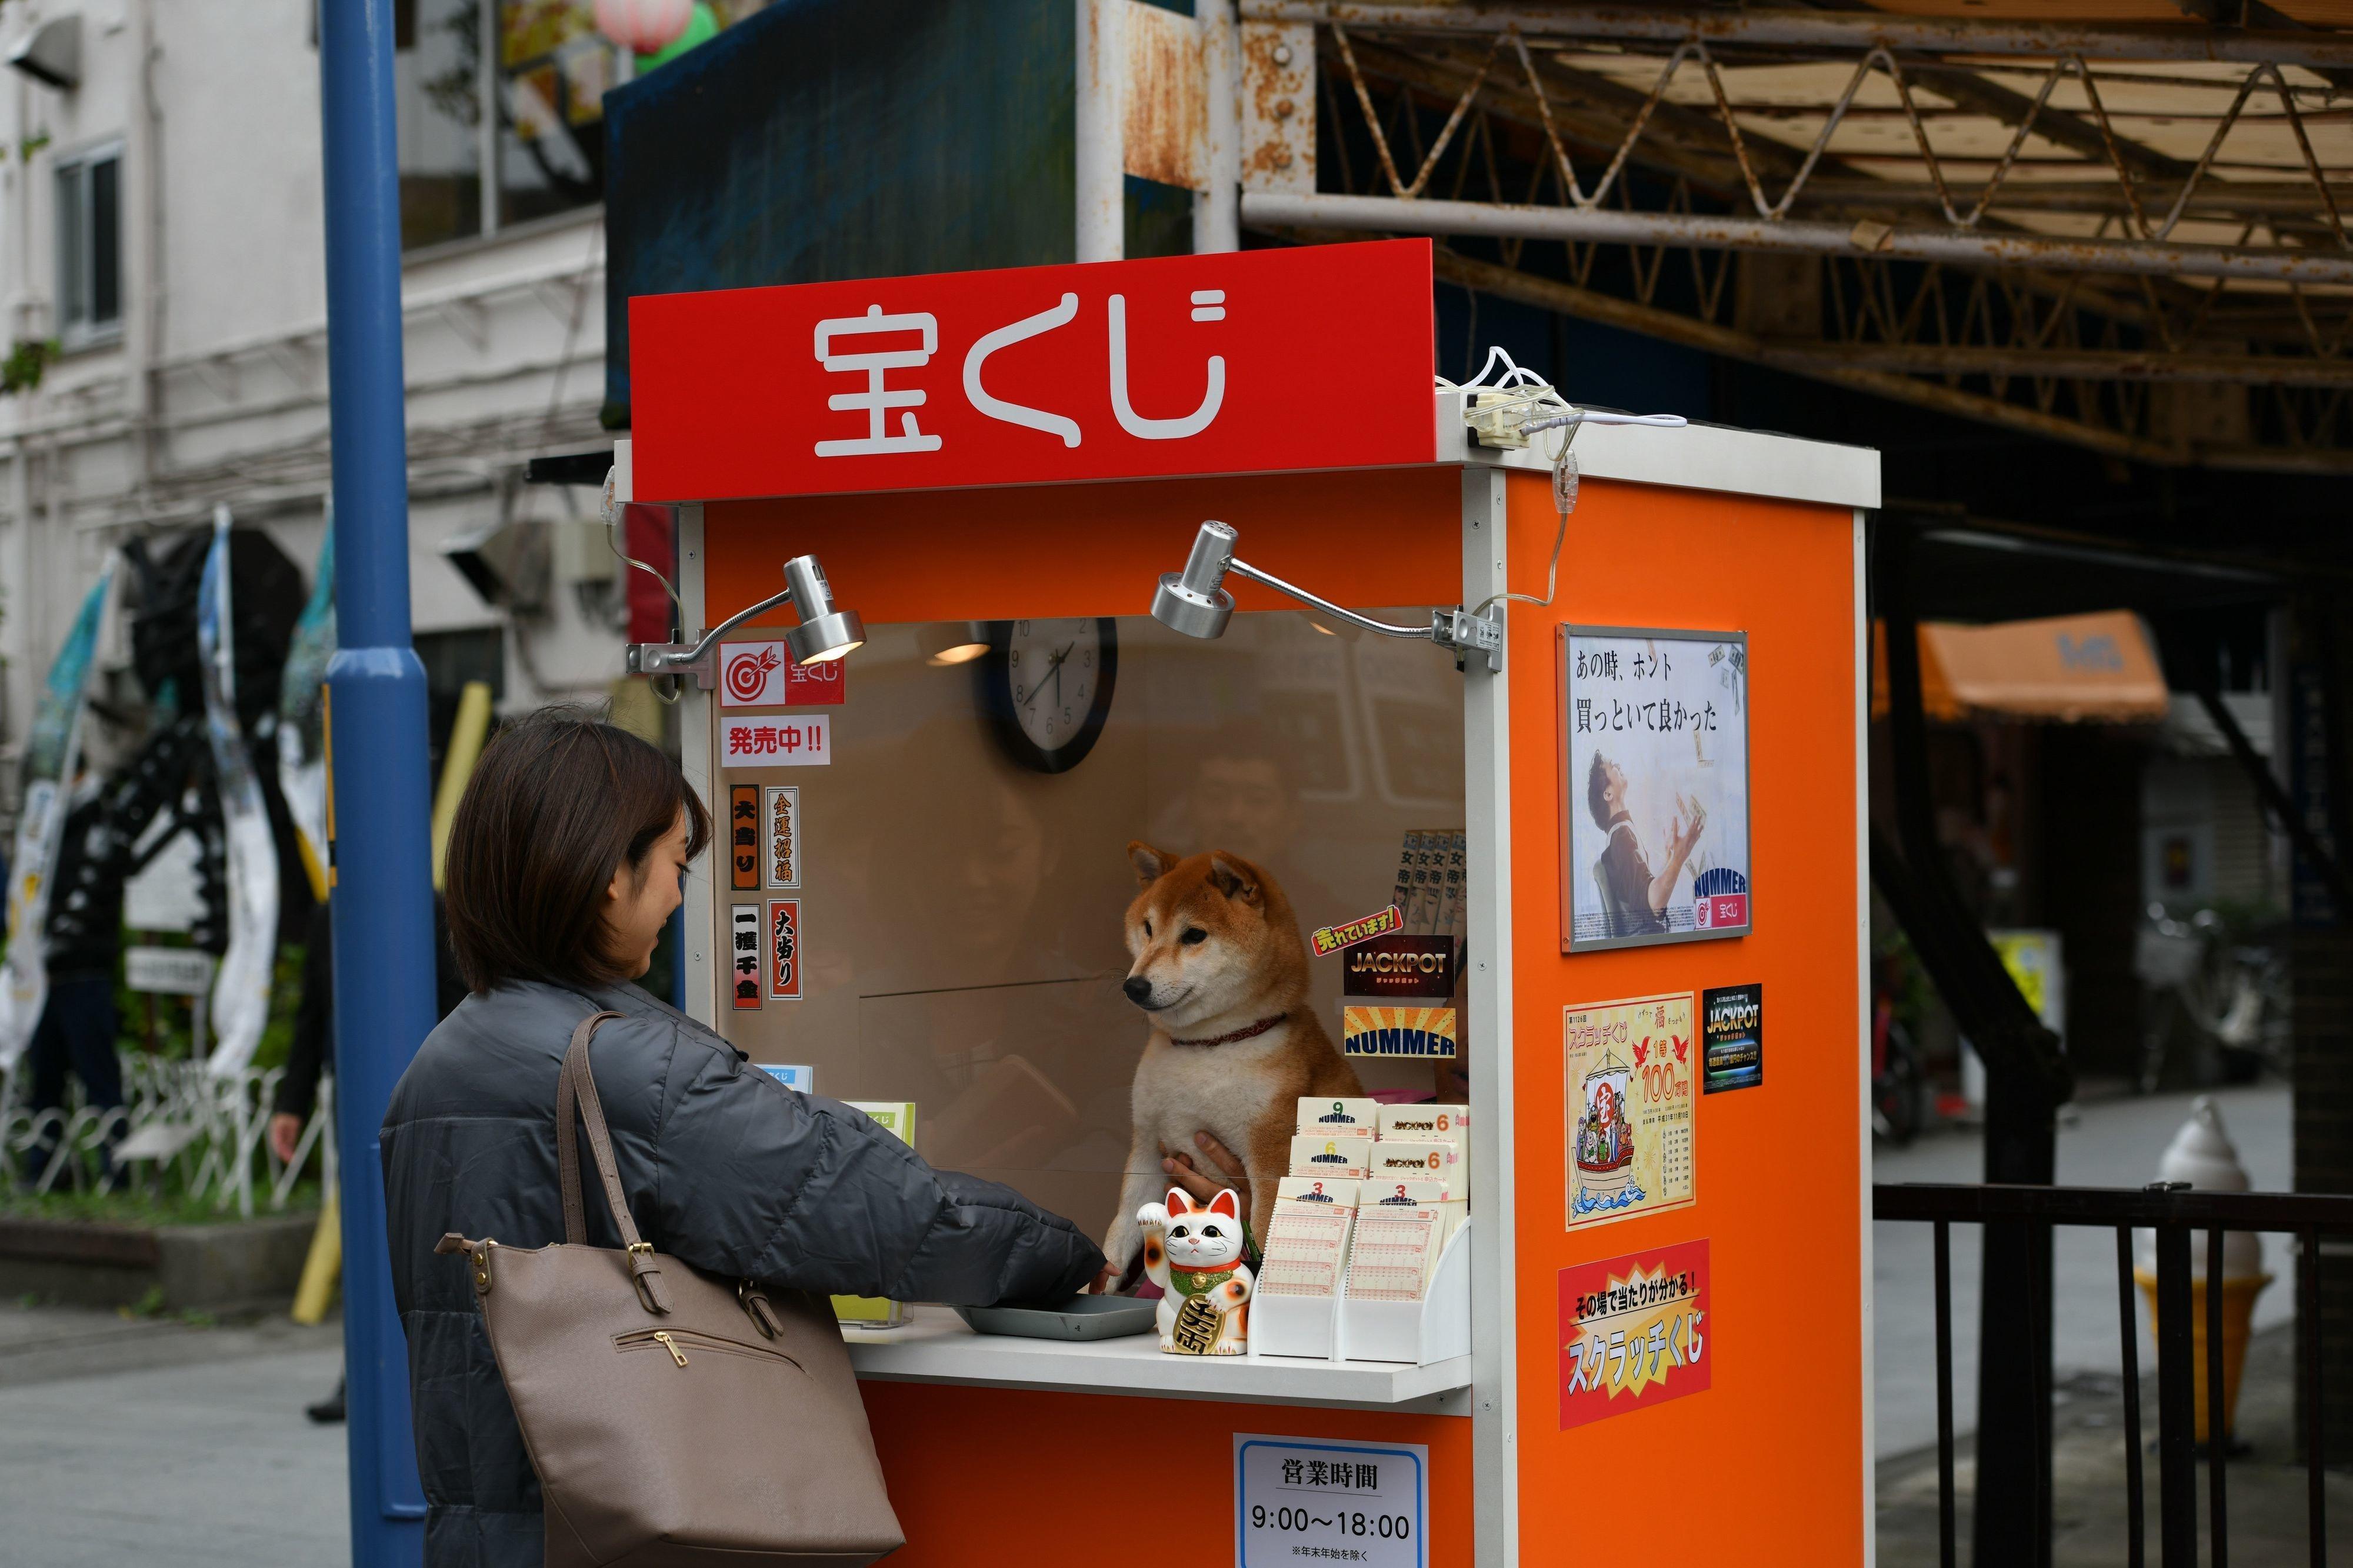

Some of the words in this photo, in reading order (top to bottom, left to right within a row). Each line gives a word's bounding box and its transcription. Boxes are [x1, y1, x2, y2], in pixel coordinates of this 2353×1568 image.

[814, 289, 1225, 458] 宝くじ
[1018, 620, 1029, 636] 10
[1079, 619, 1086, 633] 2
[1012, 650, 1019, 668] 9
[1084, 650, 1091, 668] 3
[1016, 685, 1023, 702] 8
[1078, 684, 1084, 699] 4
[1029, 708, 1035, 725] 7
[1064, 707, 1071, 725] 5
[1577, 698, 1717, 733] 買っといて良かった
[1046, 717, 1053, 734] 6
[774, 793, 792, 882] 金運招福
[1398, 851, 1414, 883] 女帝
[1415, 852, 1430, 884] 女帝
[1429, 852, 1445, 884] 女帝
[1447, 852, 1463, 884] 女帝
[1695, 868, 1745, 897] NUMMER
[1719, 903, 1737, 918] 宝くじ
[774, 910, 795, 986] 大当り
[1351, 952, 1446, 973] JACKPOT
[1569, 1015, 1587, 1023] 第1126回
[1655, 1006, 1665, 1029] 福
[1707, 1005, 1759, 1034] JACKPOT
[1345, 1028, 1455, 1055] NUMMER
[1569, 1021, 1627, 1050] スクラッチくじ
[1654, 1040, 1667, 1058] 1等
[1642, 1062, 1688, 1103] 100万円
[1333, 1102, 1343, 1115] 9
[1319, 1113, 1355, 1123] NUMMER
[1392, 1120, 1435, 1130] JACKPOT
[1437, 1113, 1449, 1132] 6
[1325, 1142, 1336, 1155] 6
[1311, 1154, 1348, 1164] NUMMER
[1383, 1157, 1426, 1168] JACKPOT
[1428, 1151, 1440, 1170] 6
[1311, 1182, 1323, 1195] 3
[1394, 1185, 1406, 1199] 3
[1296, 1194, 1334, 1203] NUMMER
[1379, 1196, 1417, 1206] NUMMER
[1567, 1310, 1704, 1396] スクラッチくじ
[1281, 1459, 1378, 1490] 営業時間
[1292, 1546, 1368, 1562] ※年末年始を除く
